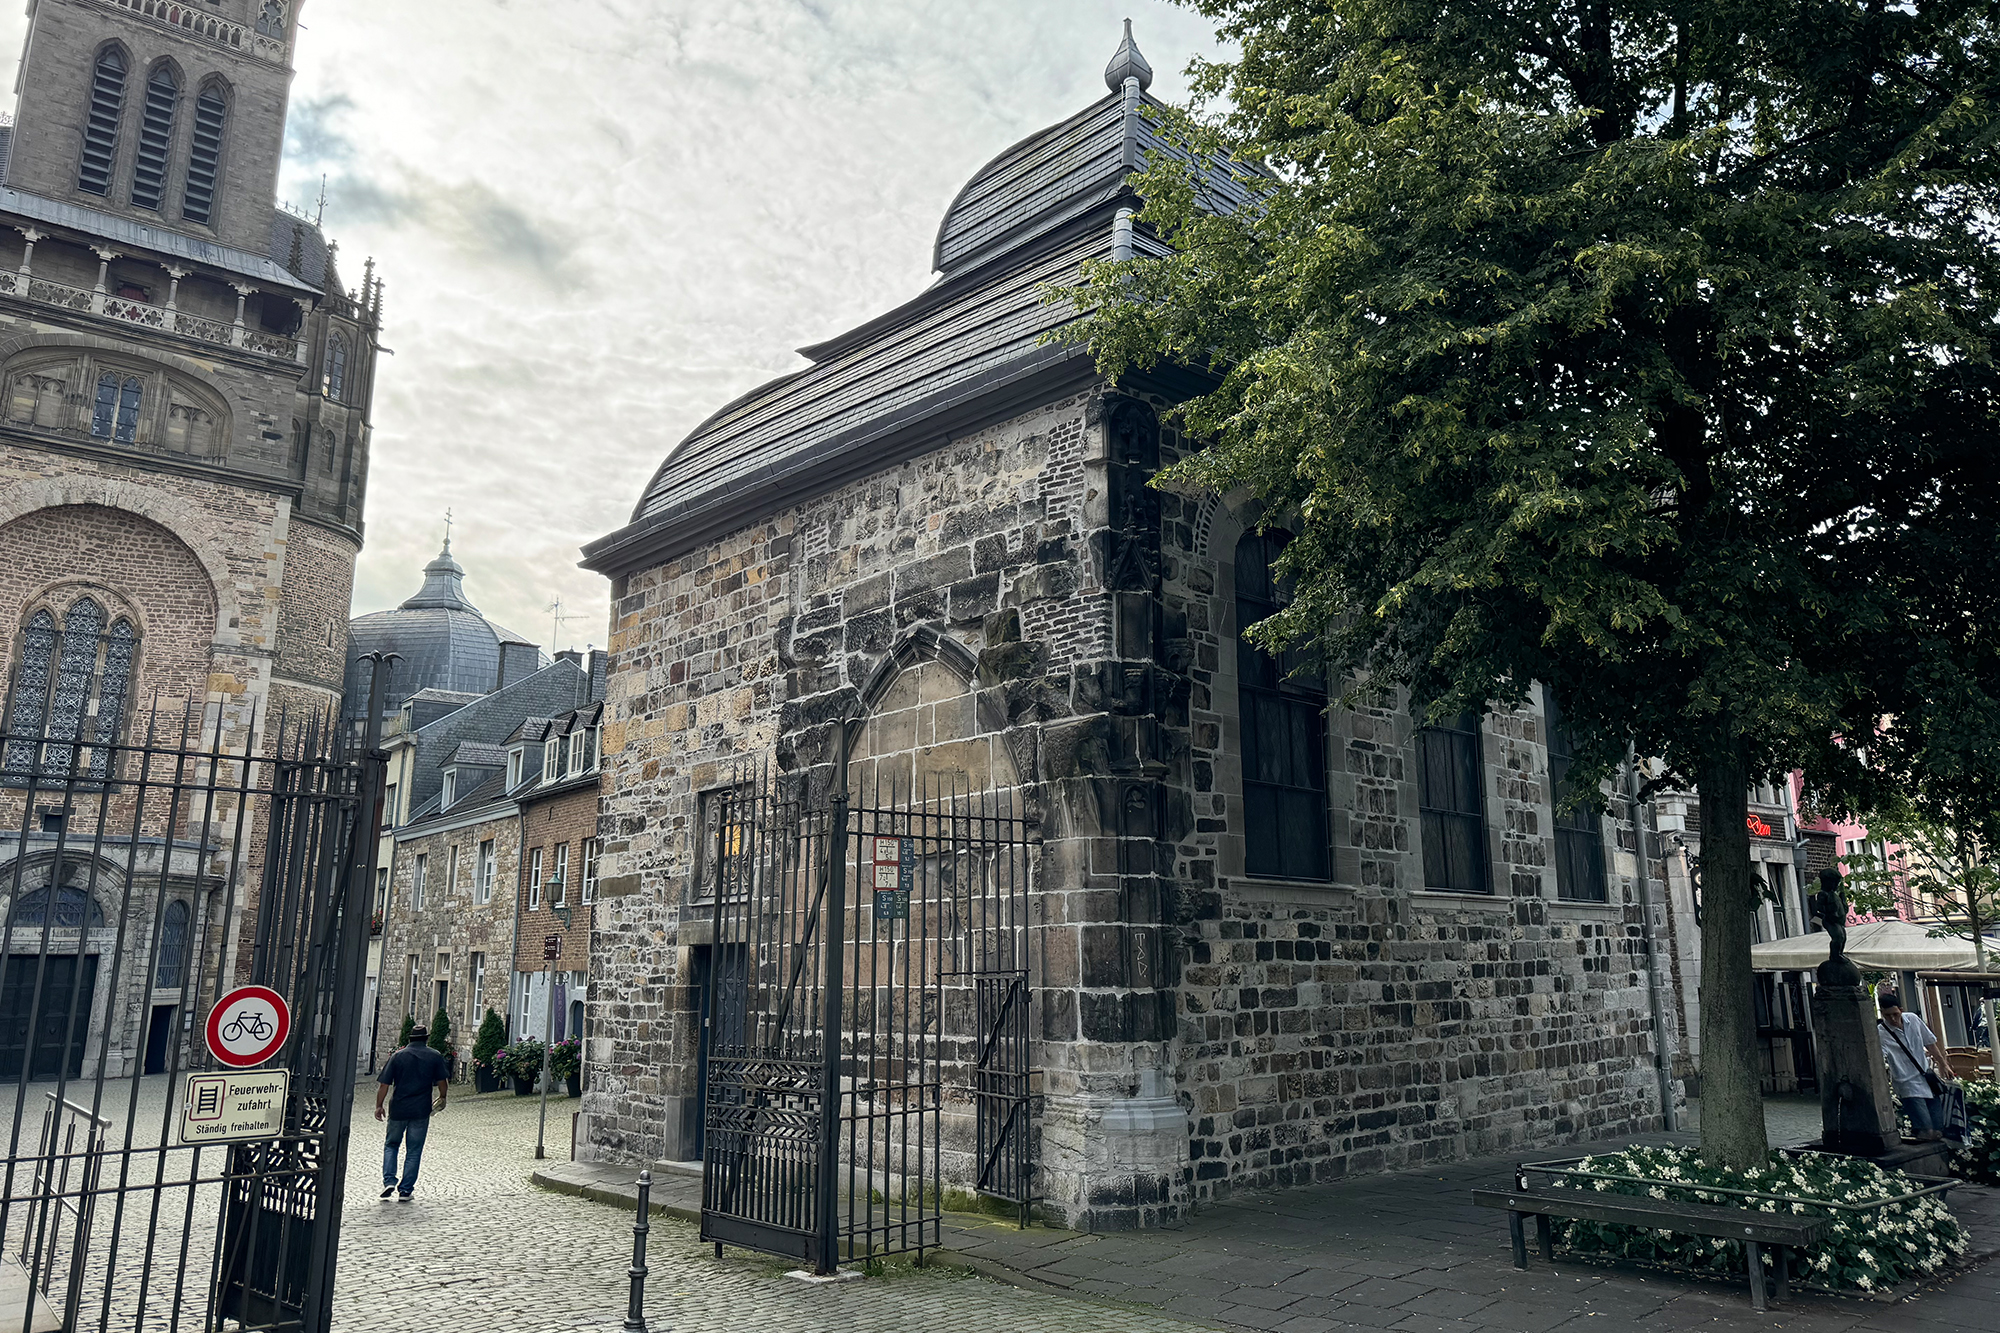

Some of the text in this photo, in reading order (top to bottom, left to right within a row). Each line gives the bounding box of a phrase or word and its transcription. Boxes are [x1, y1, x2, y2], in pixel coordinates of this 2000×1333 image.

[229, 1083, 283, 1096] Feuerwehr-
[237, 1099, 271, 1111] zufahrt
[196, 1120, 269, 1135] Ständig freihalten
